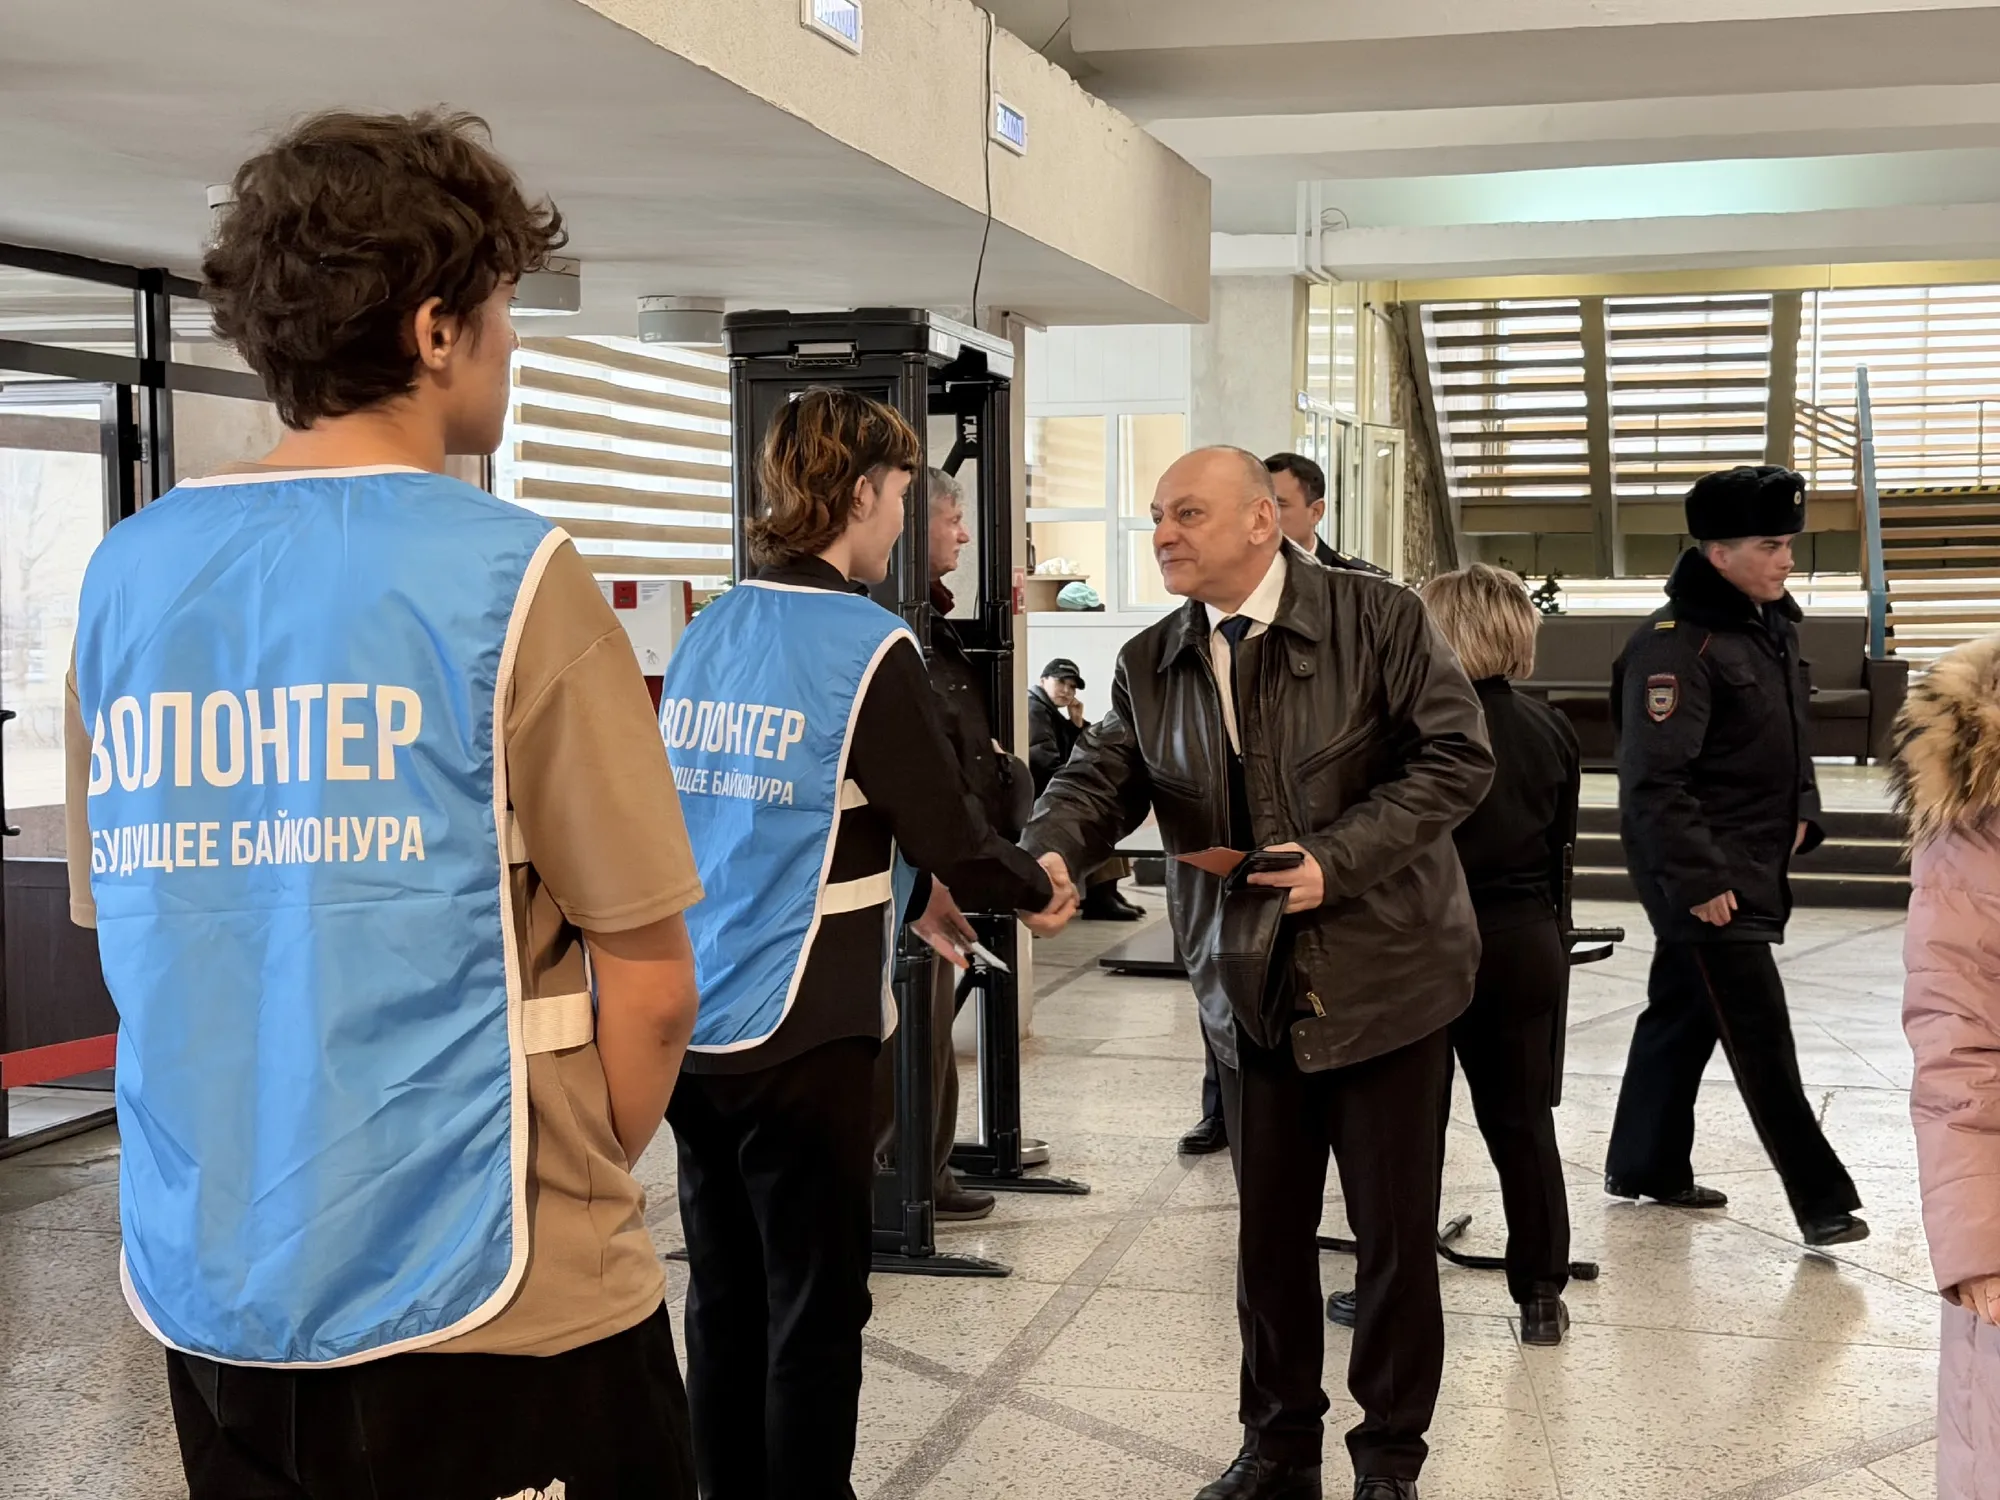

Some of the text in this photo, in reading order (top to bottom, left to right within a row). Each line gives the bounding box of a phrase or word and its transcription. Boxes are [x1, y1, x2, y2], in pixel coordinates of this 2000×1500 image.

[88, 683, 423, 796] ВОЛОНТЕР
[661, 697, 806, 761] ВОЛОНТЕР
[712, 767, 793, 806] БАЙКОНУРА
[92, 810, 426, 877] БУДУЩЕЕ БАЙКОНУРА
